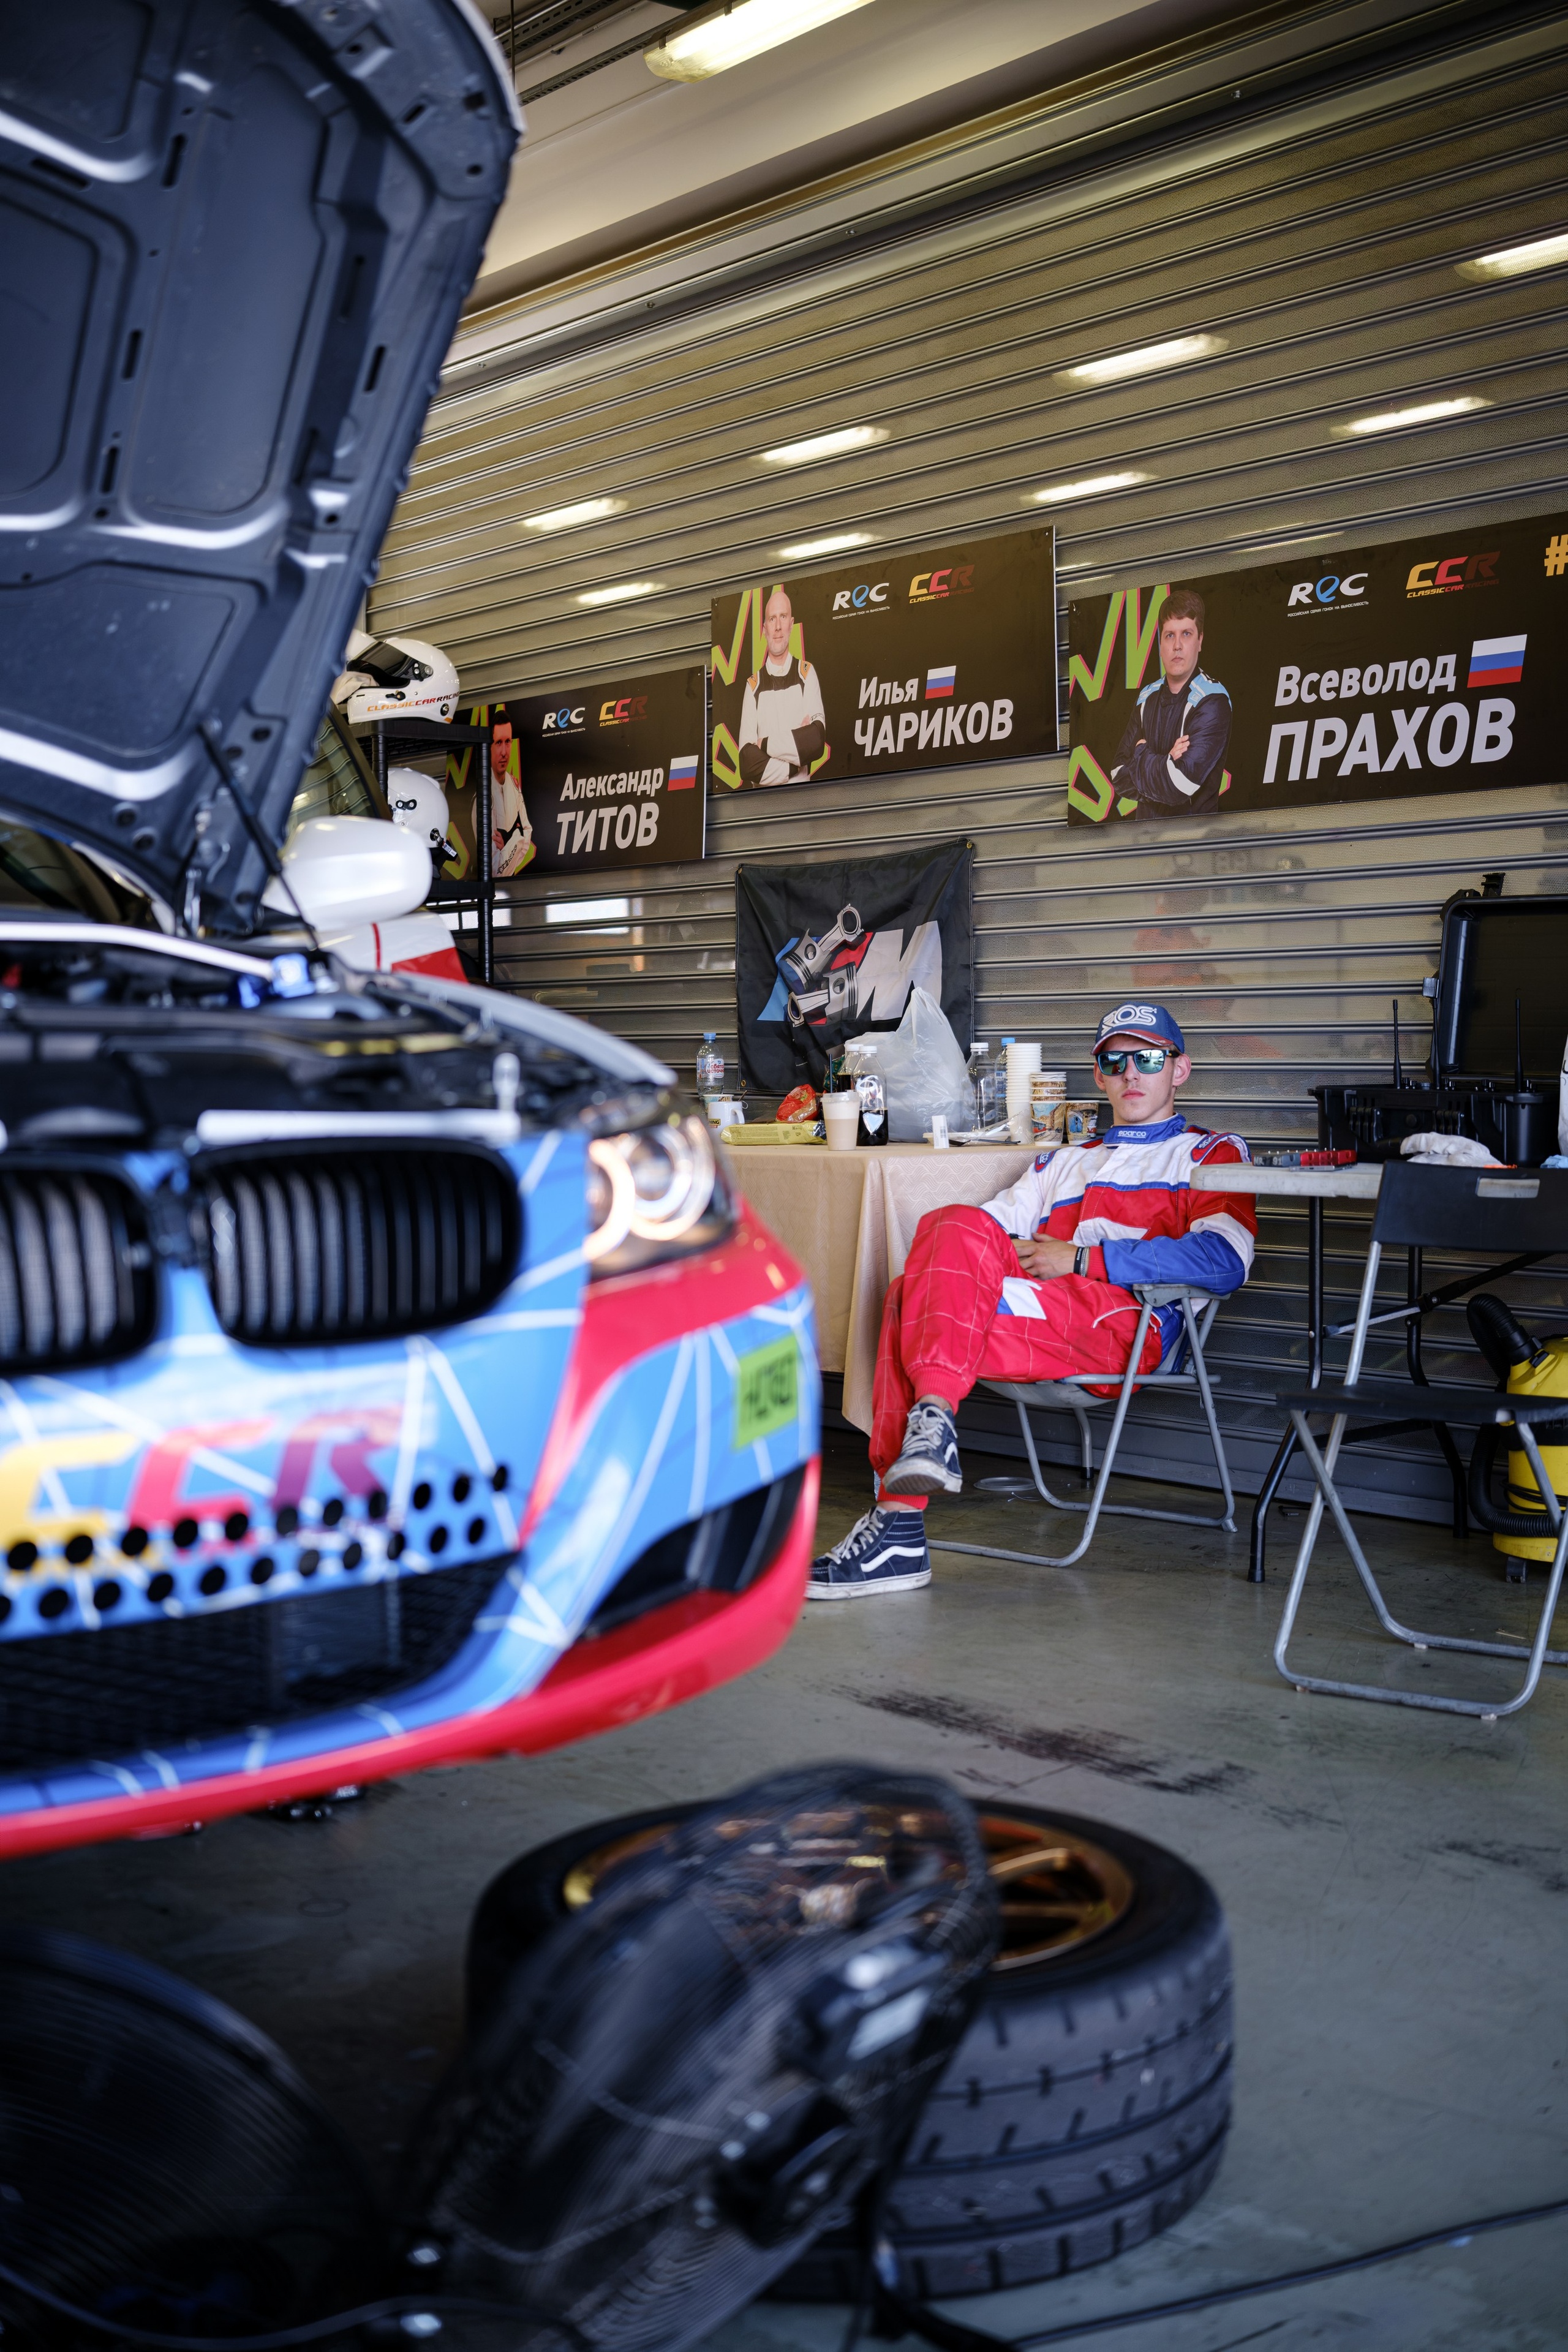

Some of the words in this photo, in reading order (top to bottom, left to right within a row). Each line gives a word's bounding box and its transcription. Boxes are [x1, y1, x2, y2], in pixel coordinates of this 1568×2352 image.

[908, 564, 974, 597] CCR
[1406, 551, 1501, 590] CCR
[858, 677, 919, 709] Илья
[1275, 654, 1457, 707] Всеволод
[599, 696, 648, 721] CCR
[854, 698, 1014, 756] ЧАРИКОВ
[1263, 698, 1516, 783] ПРАХОВ
[560, 767, 664, 801] Александр
[557, 802, 659, 855] ТИТОВ
